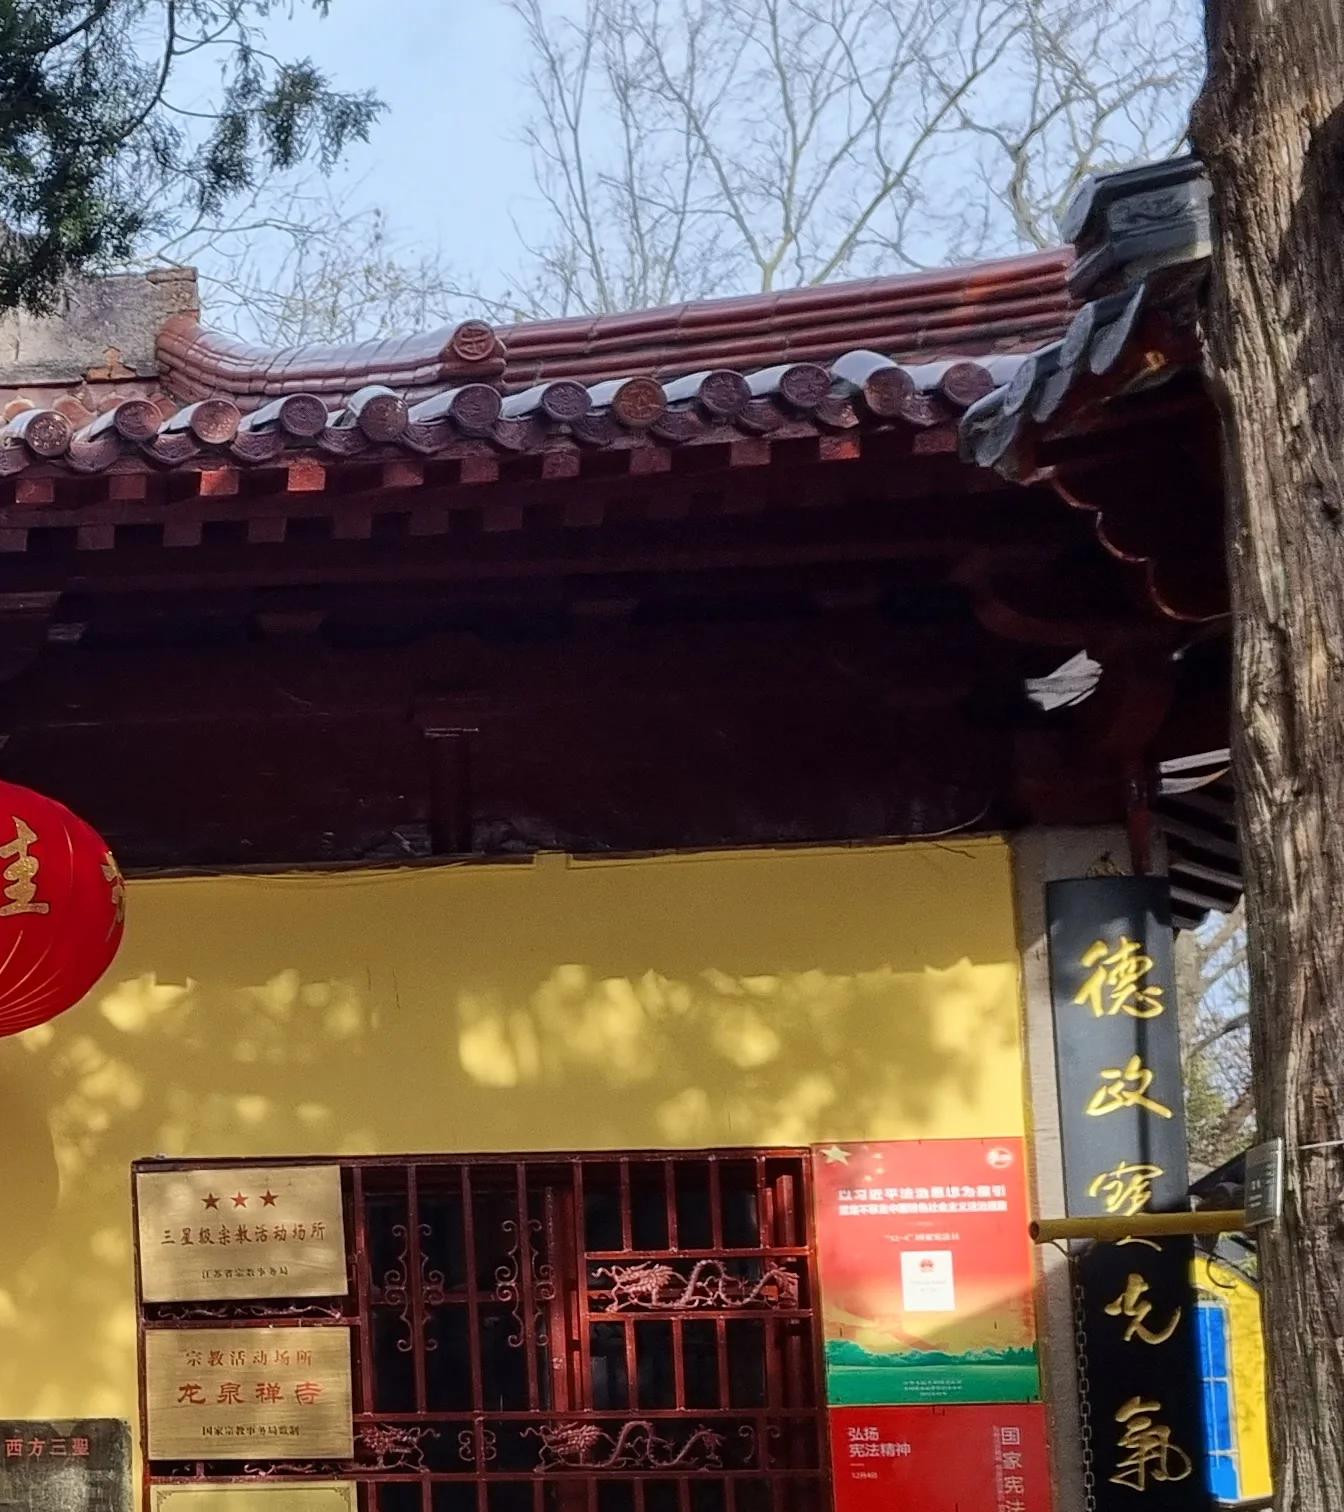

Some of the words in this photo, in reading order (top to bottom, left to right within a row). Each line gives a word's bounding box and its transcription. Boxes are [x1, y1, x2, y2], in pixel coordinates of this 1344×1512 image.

[161, 1222, 327, 1246] 三星级宗教活动场所
[186, 1350, 312, 1368] 宗教活动场所
[177, 1380, 323, 1406] 龙泉禅寺
[848, 1426, 880, 1442] 弘扬
[849, 1442, 912, 1458] 宪法精神
